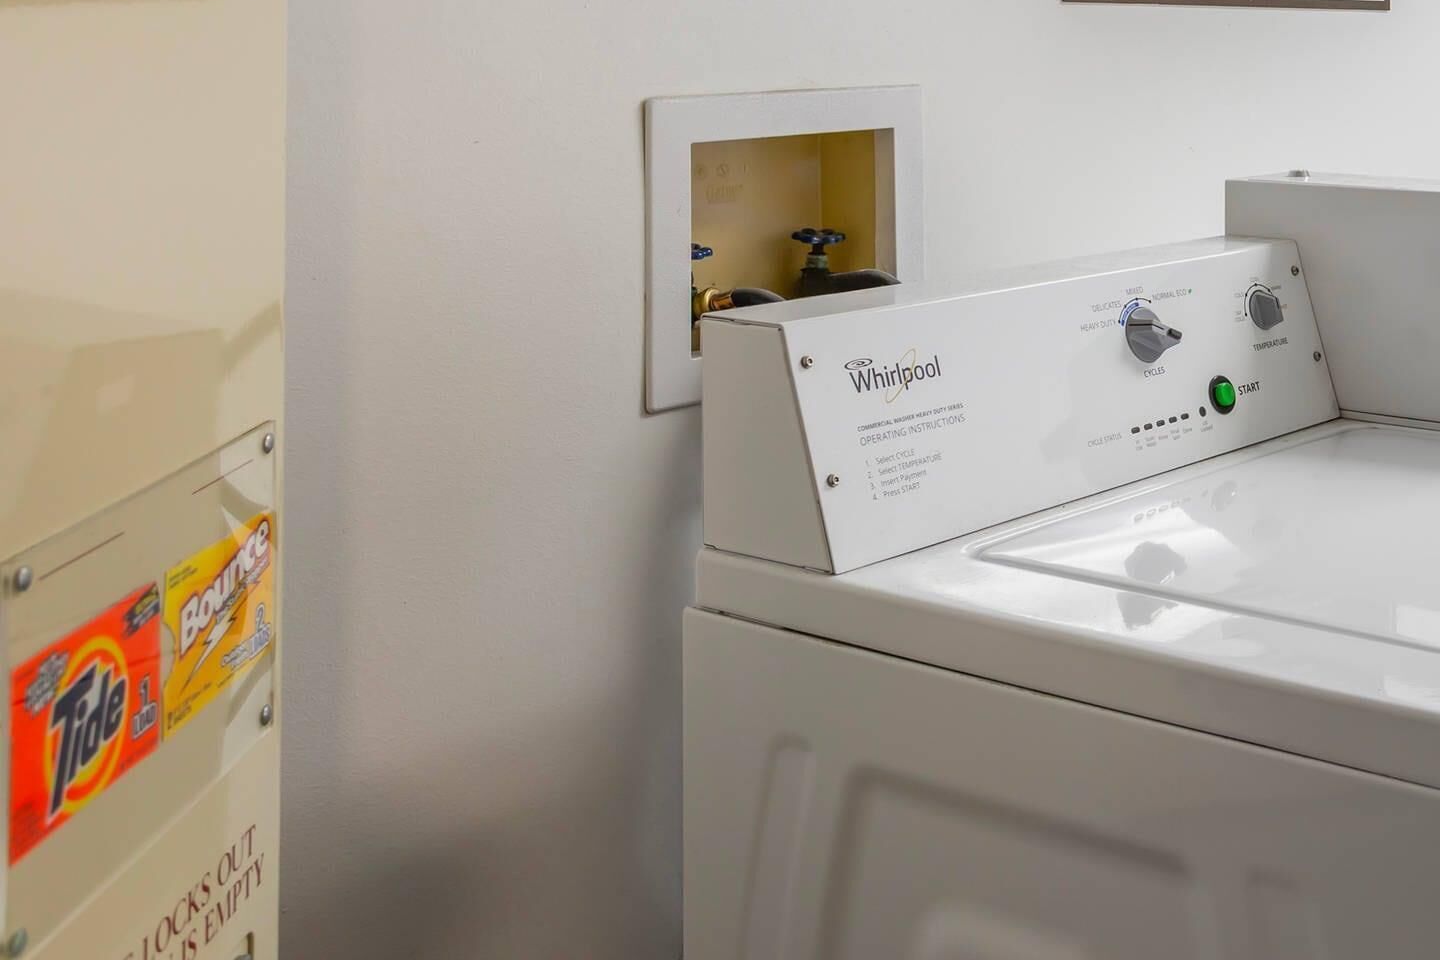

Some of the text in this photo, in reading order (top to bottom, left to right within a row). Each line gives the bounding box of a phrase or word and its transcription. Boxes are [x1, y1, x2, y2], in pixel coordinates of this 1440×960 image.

[1126, 286, 1144, 296] MIXED
[1152, 288, 1187, 301] NORMAL ECO
[1091, 300, 1122, 313] DELICATES
[1080, 319, 1117, 332] HEAVY DUTY
[1252, 336, 1289, 352] TEMPERATURE
[849, 354, 941, 393] Whirlpool
[1143, 366, 1166, 378] CYCLES
[1238, 381, 1260, 396] START
[857, 418, 893, 433] COMMERCIAL
[893, 414, 915, 424] WASHER
[947, 402, 964, 411] SERIES
[859, 413, 966, 447] OPERATING INSTRUCTIONS
[1104, 432, 1122, 444] STATUS
[875, 455, 896, 465] Select
[896, 448, 915, 460] CYCLE
[878, 466, 897, 476] Select
[898, 453, 942, 470] TEMPERATURE
[880, 477, 900, 487] Insert
[881, 488, 900, 497] Press
[48, 658, 127, 824] Tide
[217, 824, 256, 886] OUT
[204, 852, 264, 945] EMPTY
